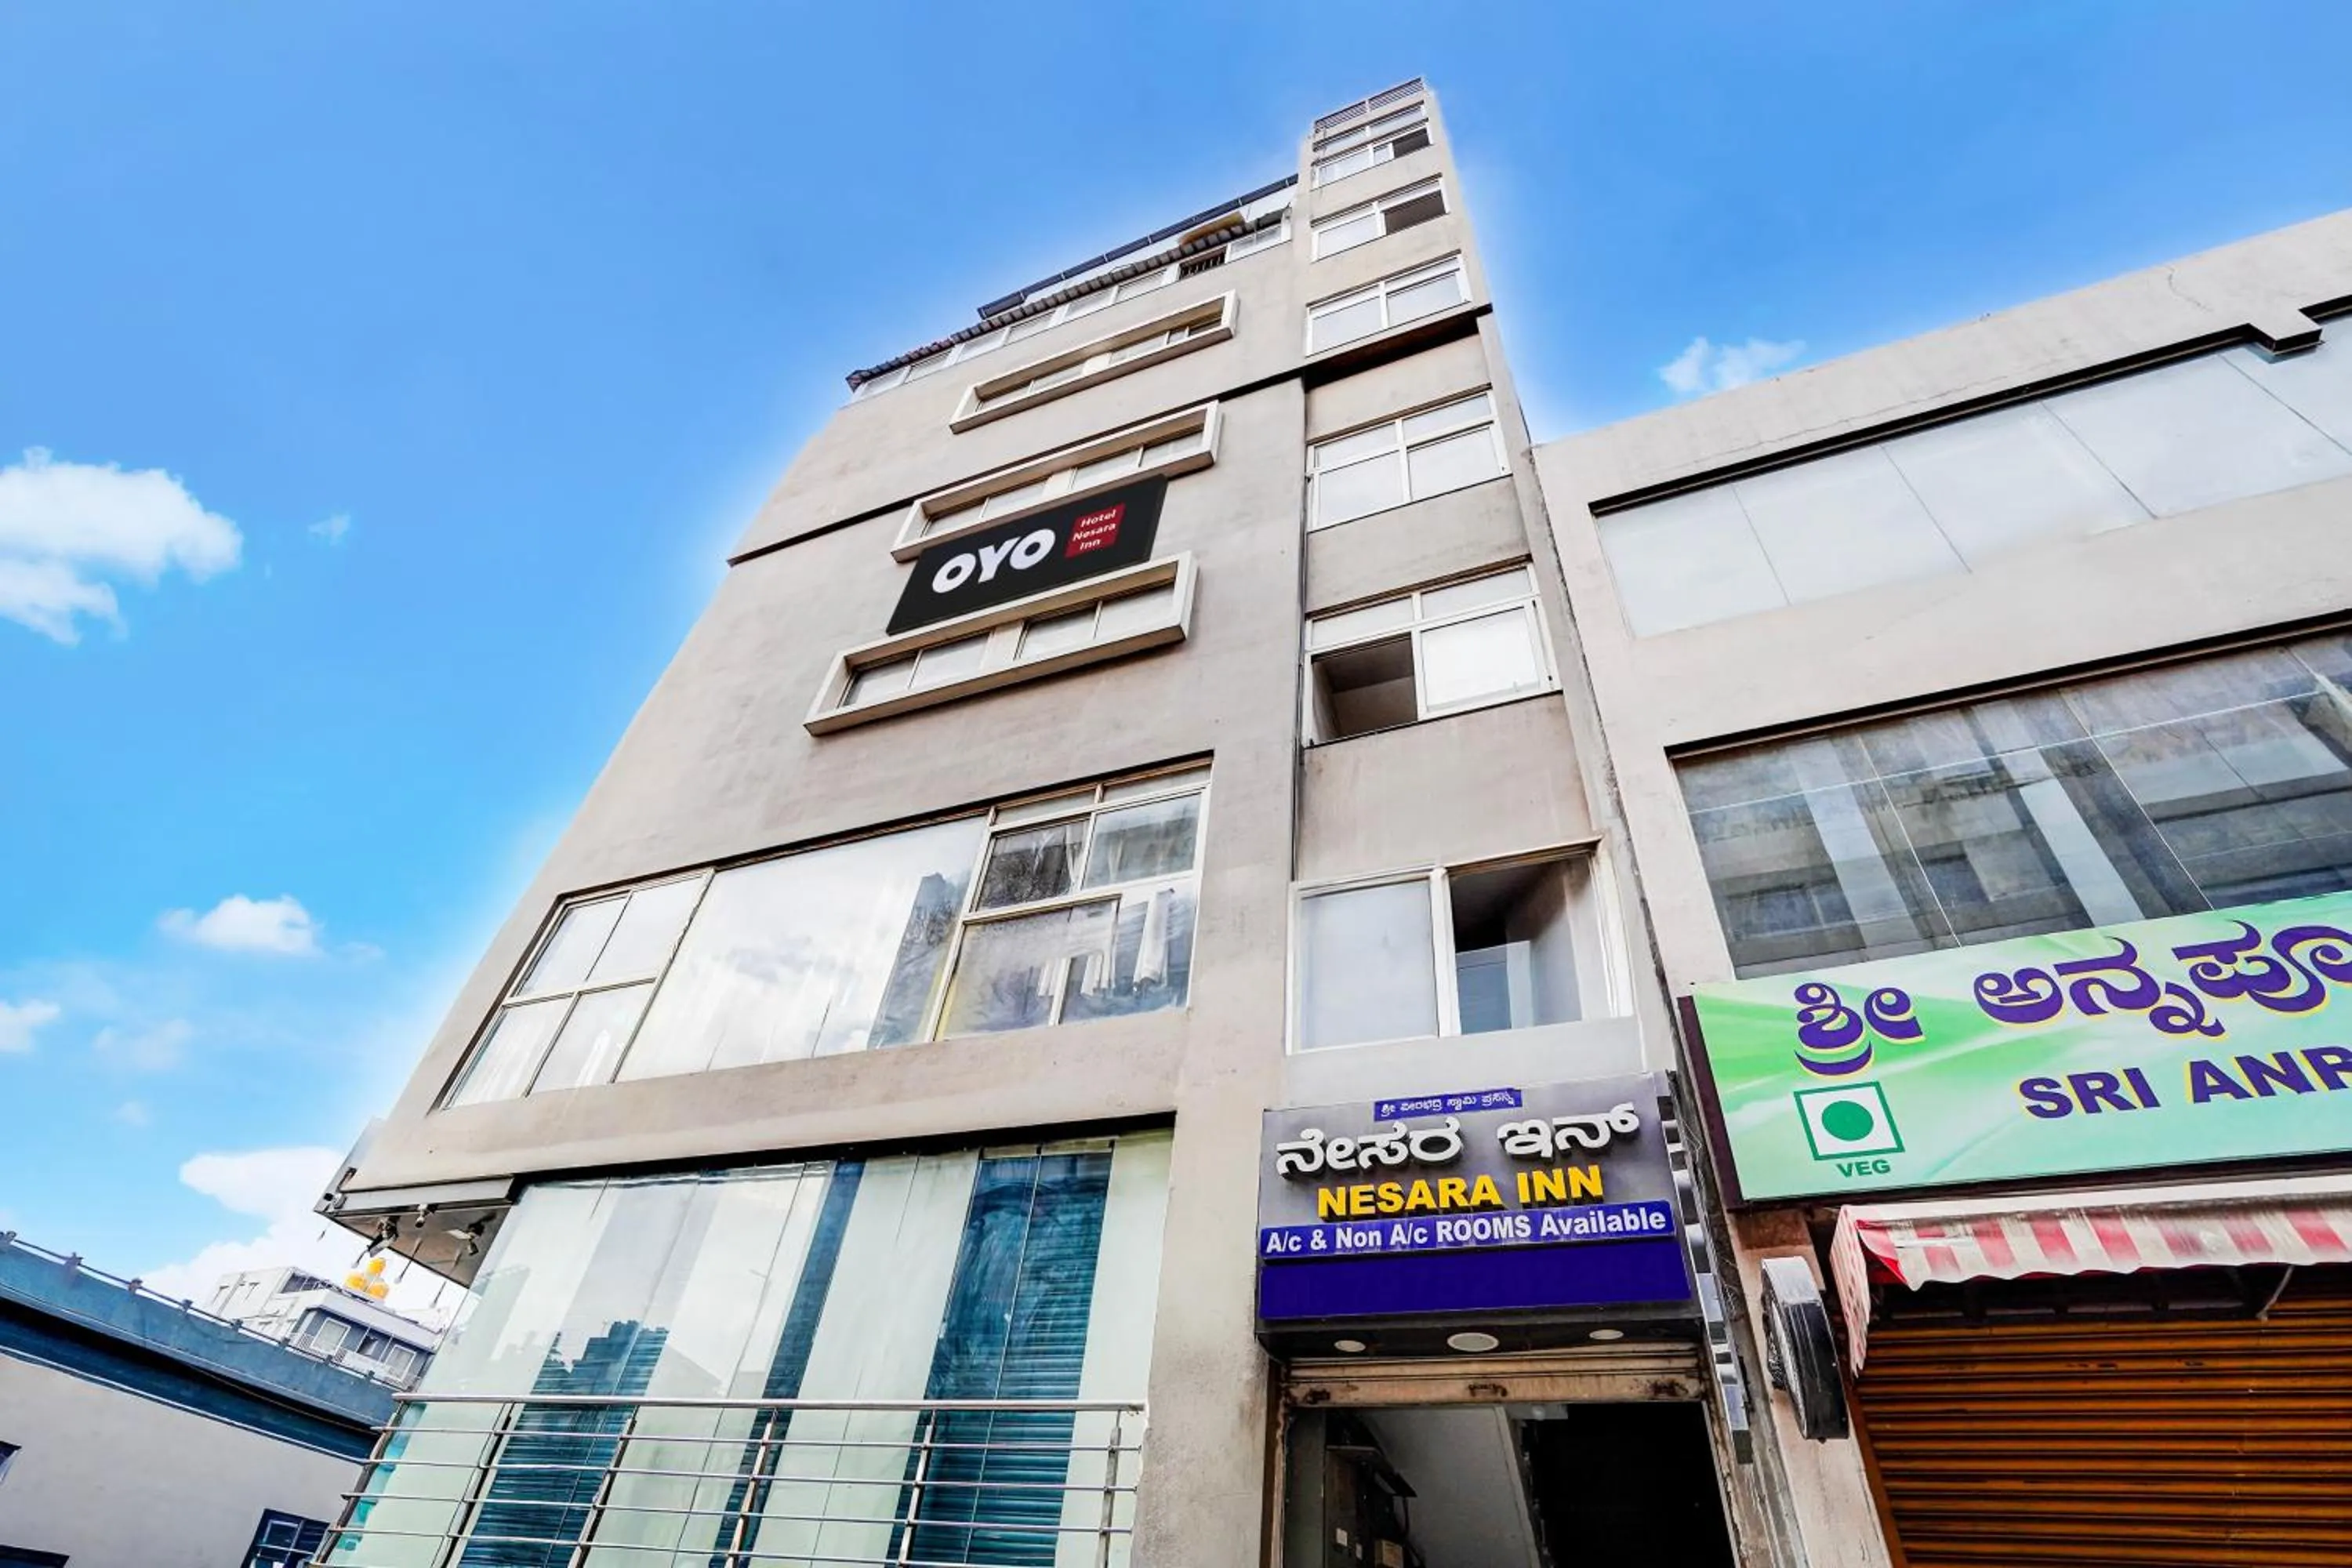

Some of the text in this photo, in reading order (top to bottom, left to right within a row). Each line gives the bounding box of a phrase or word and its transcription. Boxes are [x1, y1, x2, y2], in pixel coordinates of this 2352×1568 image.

[1073, 523, 1116, 542] Nesara
[1080, 509, 1116, 528] Hotel
[932, 528, 1056, 593] OYO
[1080, 539, 1101, 550] Inn
[1795, 982, 1924, 1077] ಶ್ರೀ
[2019, 1067, 2161, 1119] SRI
[1276, 1102, 1640, 1176] ನೇಸರ ಇನ್
[1317, 1165, 1604, 1218] NESARA INN
[1835, 1159, 1891, 1178] VEG
[1266, 1208, 1666, 1254] A/c & Non A/c ROOMS Available
